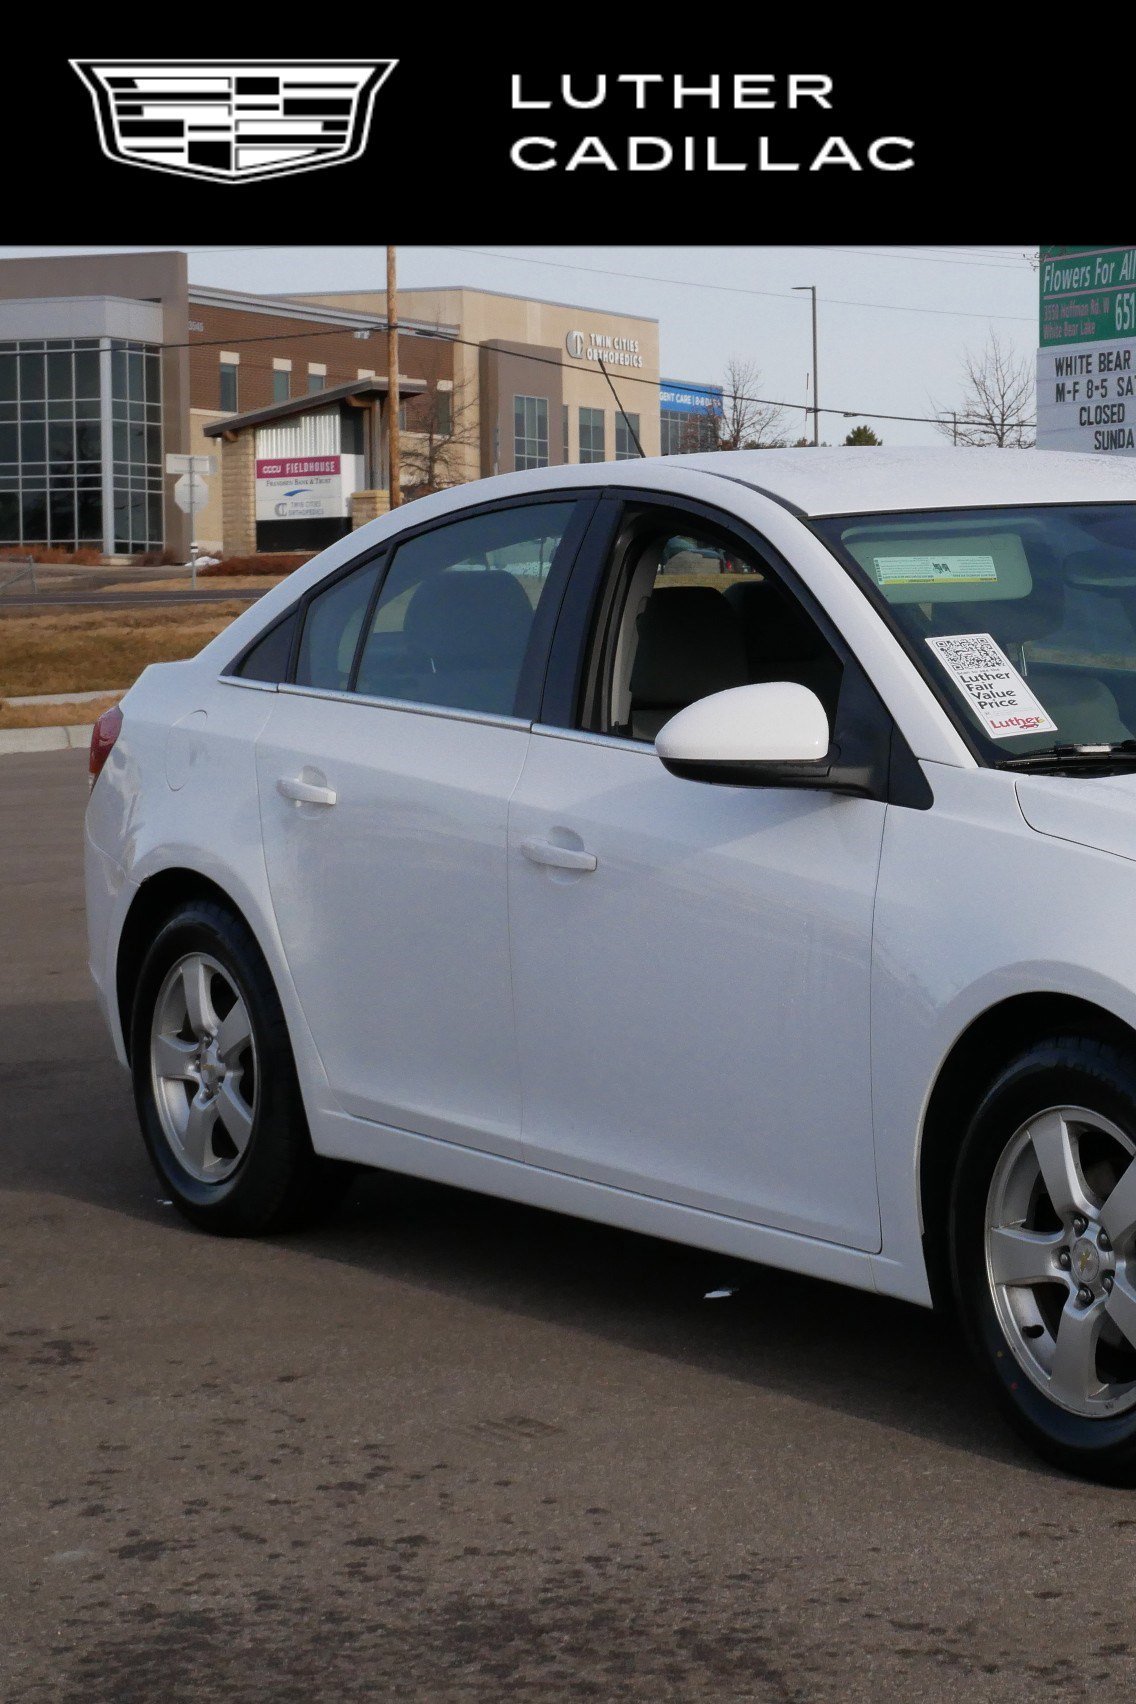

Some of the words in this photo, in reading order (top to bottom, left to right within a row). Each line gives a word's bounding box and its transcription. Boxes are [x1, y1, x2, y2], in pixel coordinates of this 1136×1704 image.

[1043, 263, 1090, 293] Flowers
[1094, 258, 1115, 285] For
[590, 333, 611, 348] TWIN
[613, 337, 640, 353] CITIES
[586, 347, 643, 368] ORTHOPEDICS
[1055, 353, 1092, 377] WHITE
[1098, 350, 1131, 372] BEAR
[1055, 381, 1079, 402] M-F
[1086, 378, 1108, 399] 8-5
[1079, 402, 1125, 426] CLOSED
[286, 461, 336, 474] FIELDHOUSE
[960, 672, 1010, 683] Luther
[965, 682, 994, 692] Fair
[971, 690, 1017, 700] Value
[978, 699, 1018, 709] Price
[989, 716, 1041, 729] Luther
